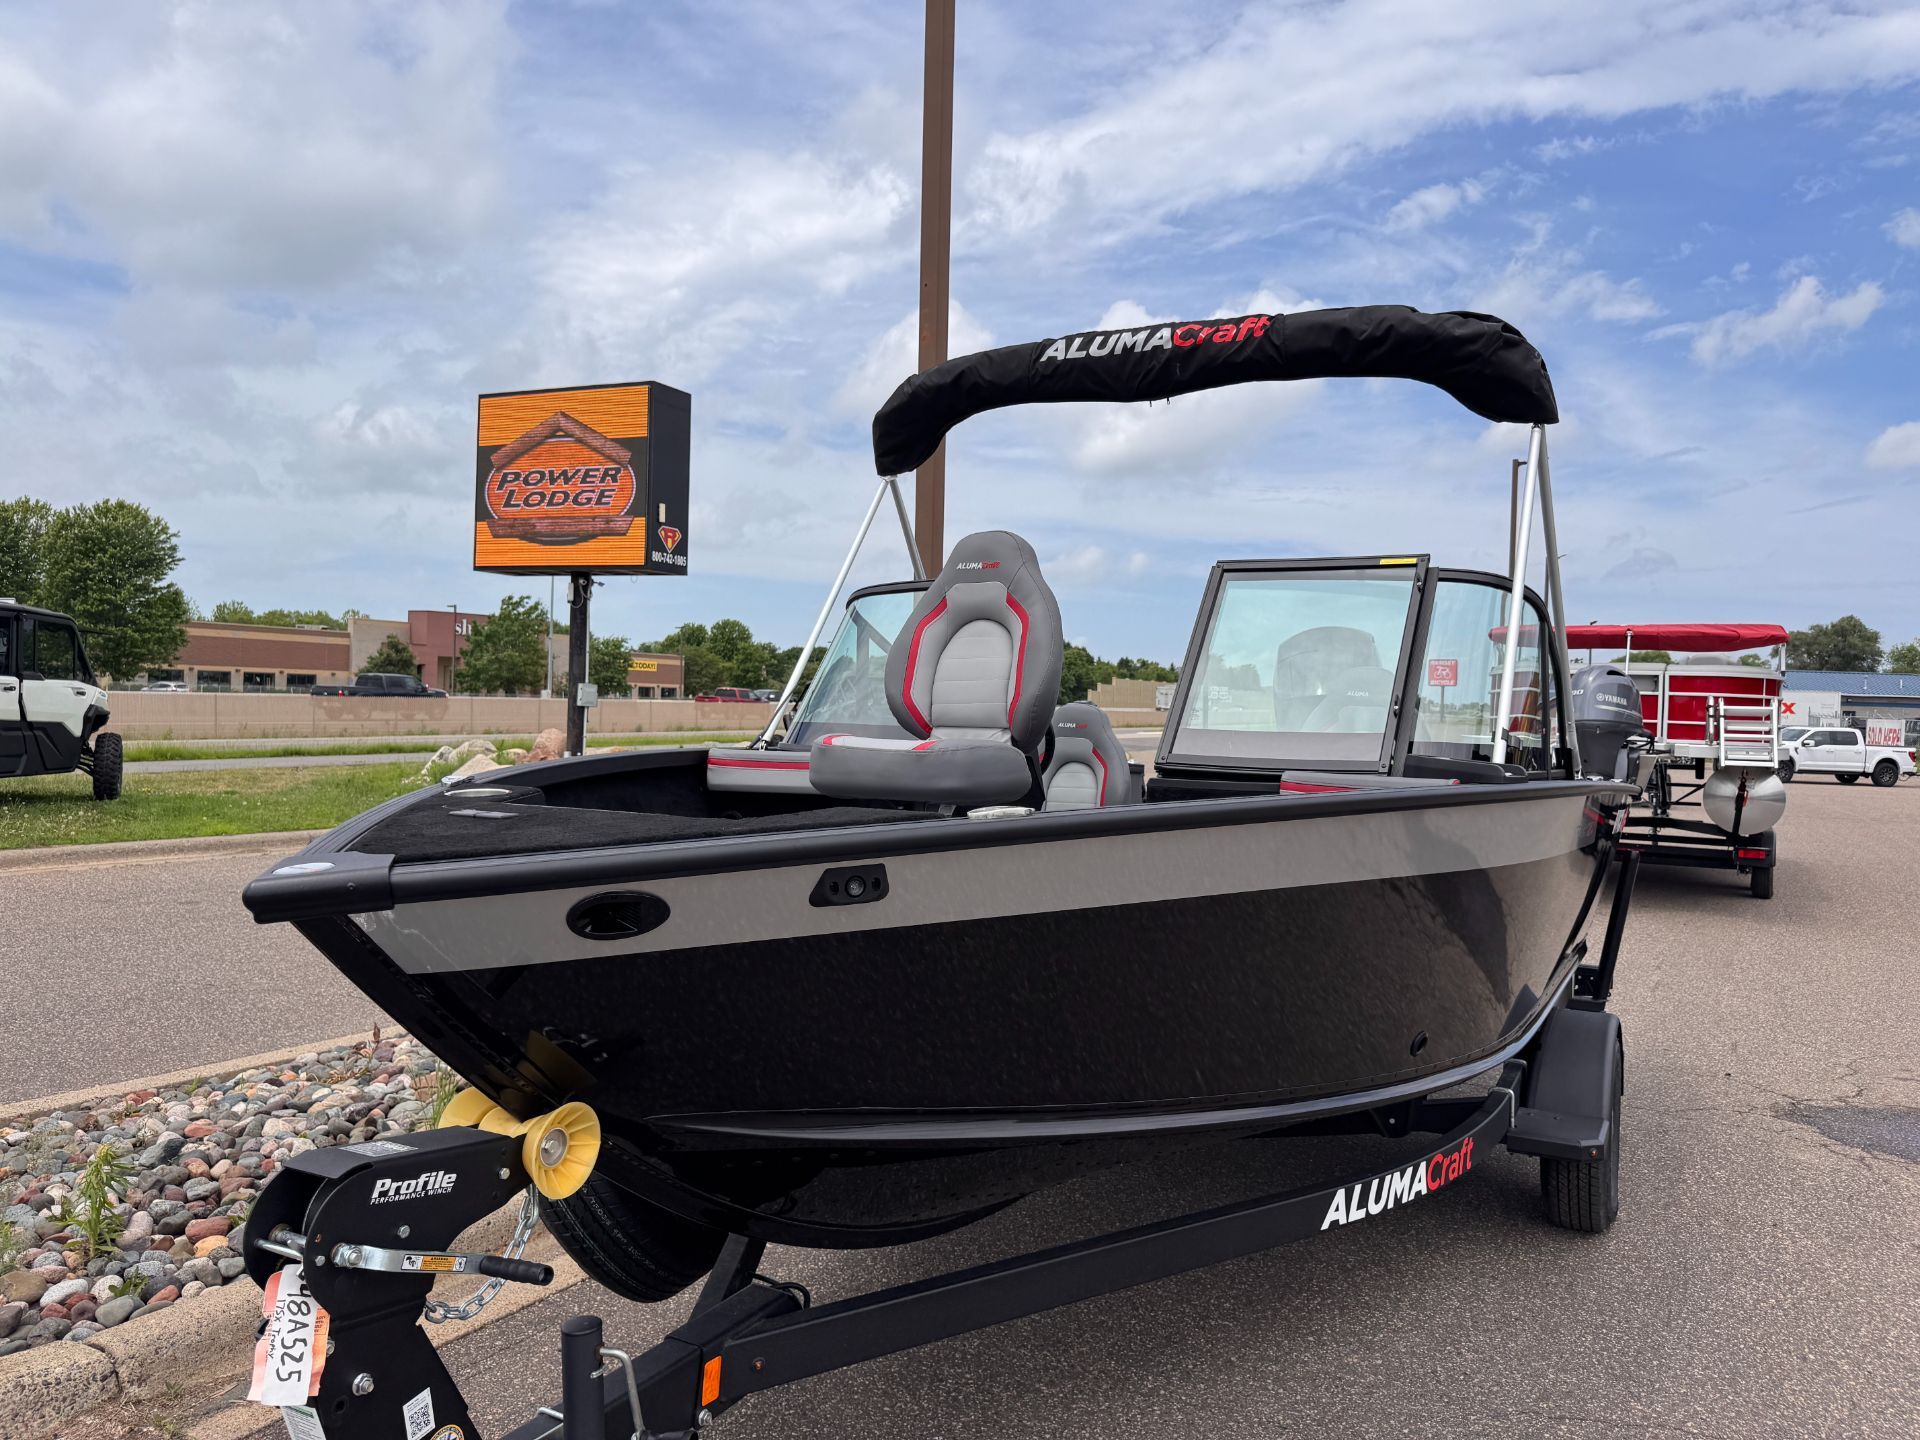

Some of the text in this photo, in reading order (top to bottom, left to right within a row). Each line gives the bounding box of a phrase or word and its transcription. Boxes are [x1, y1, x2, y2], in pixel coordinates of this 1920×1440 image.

[1040, 315, 1271, 361] ALUMACraft
[496, 466, 623, 491] POWER
[501, 489, 616, 510] LODGE
[1604, 694, 1628, 705] YAMAHA
[370, 1186, 453, 1205] PERFORMANCE WINCH
[371, 1170, 457, 1199] Profile
[1320, 1137, 1474, 1230] ALUMACraft
